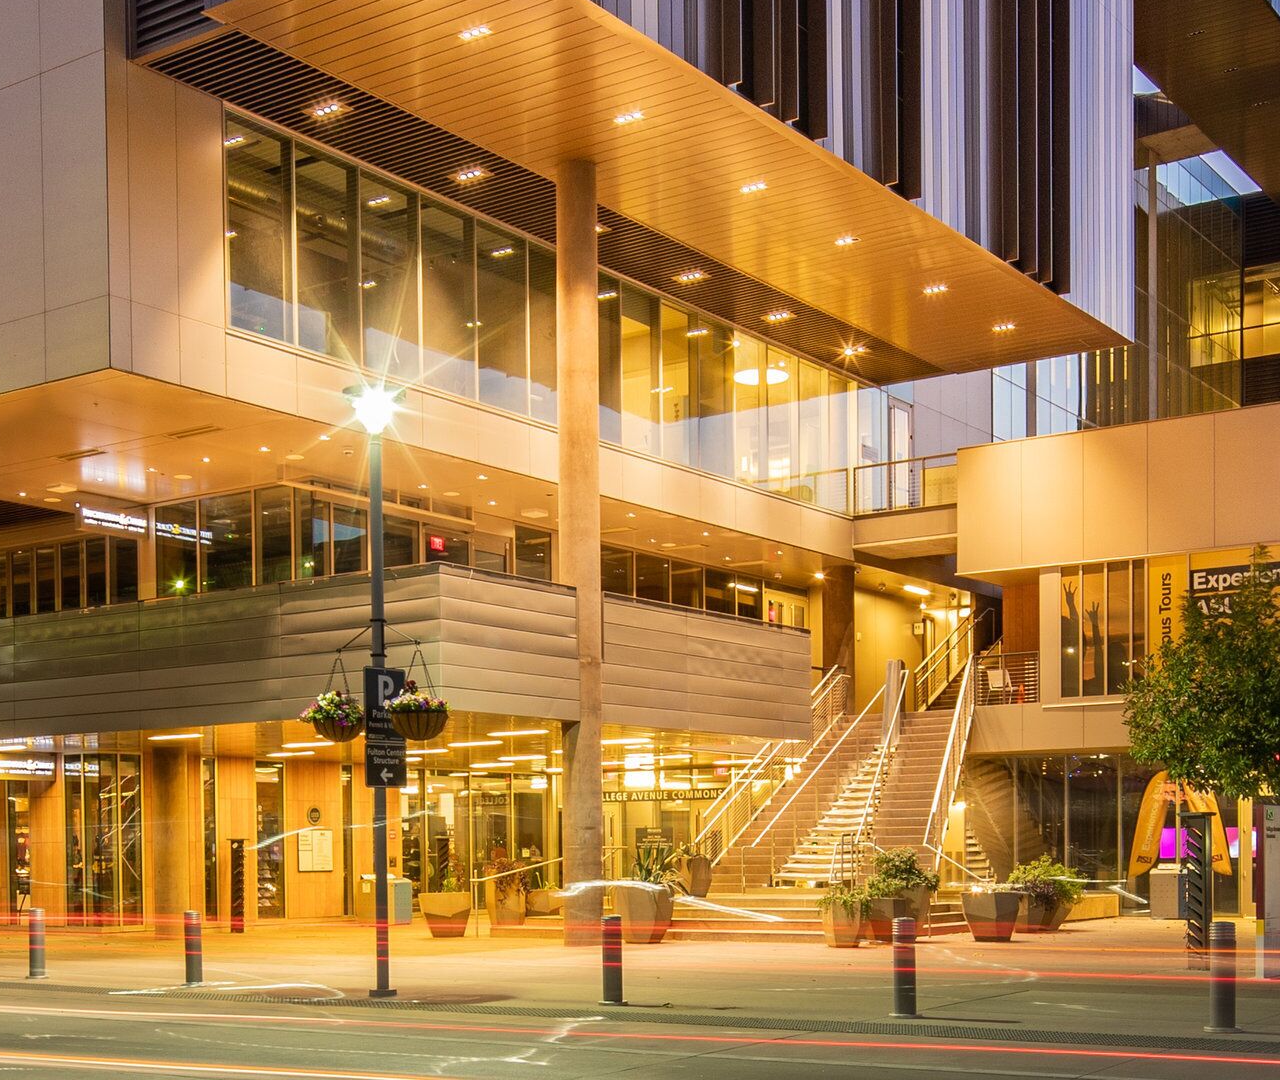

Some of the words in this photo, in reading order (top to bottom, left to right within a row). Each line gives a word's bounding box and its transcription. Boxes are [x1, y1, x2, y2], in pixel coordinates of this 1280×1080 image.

[1159, 572, 1172, 614] Tours
[378, 674, 394, 707] P
[367, 748, 386, 756] Fulton
[373, 757, 400, 765] Structure
[631, 790, 668, 800] AVENUE
[672, 789, 723, 799] COMMONS
